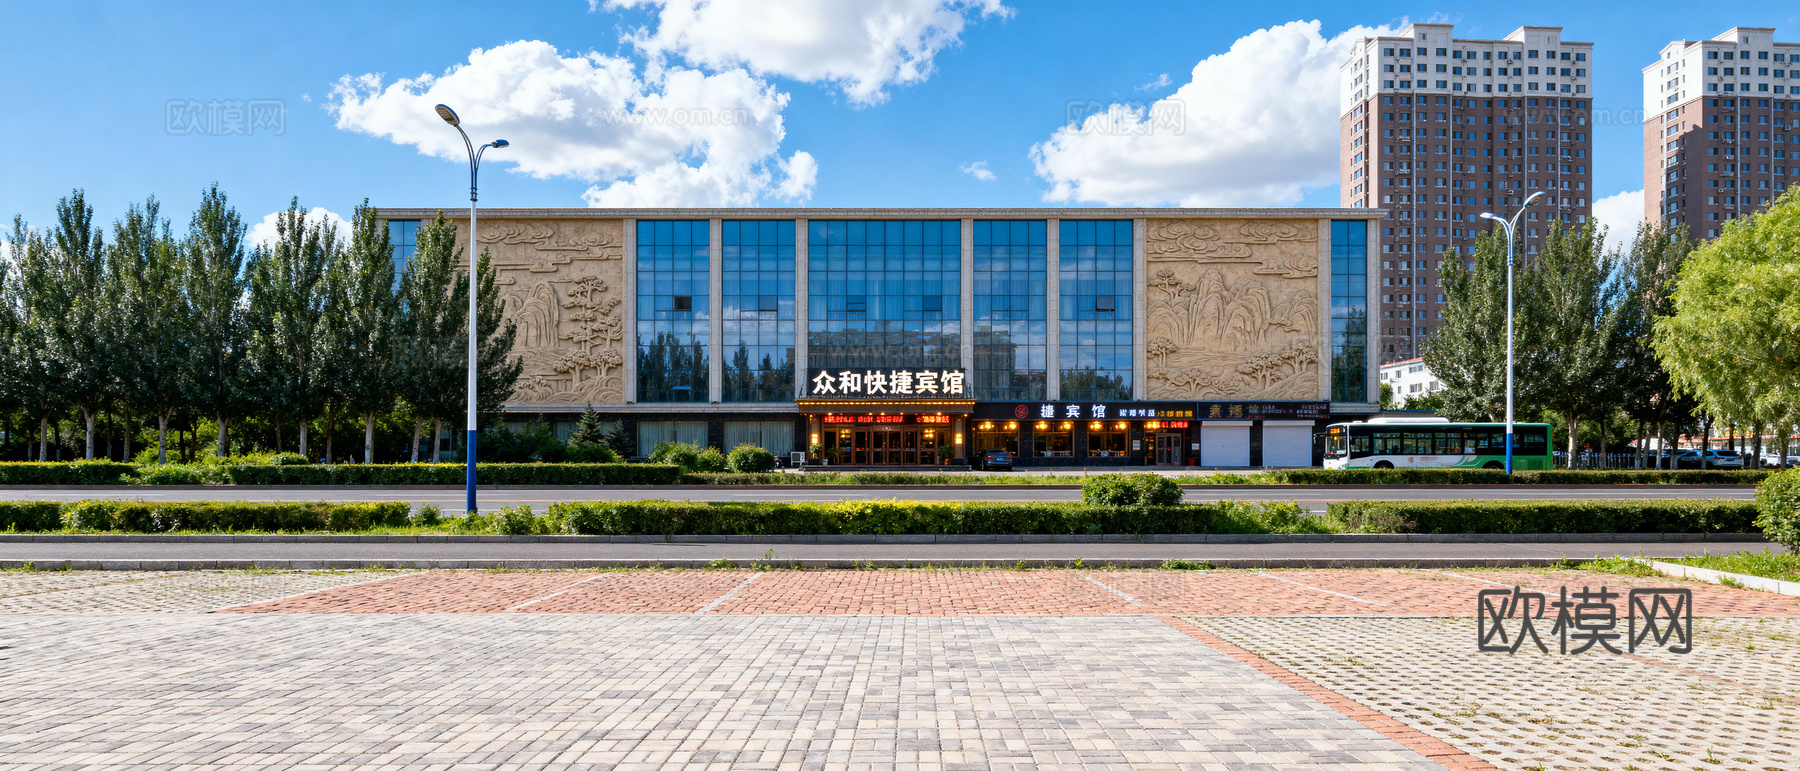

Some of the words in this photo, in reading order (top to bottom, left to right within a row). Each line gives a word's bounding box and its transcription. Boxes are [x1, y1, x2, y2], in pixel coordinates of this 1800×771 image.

[812, 369, 965, 395] 众和快捷宾馆
[1040, 403, 1106, 418] 捷宾馆
